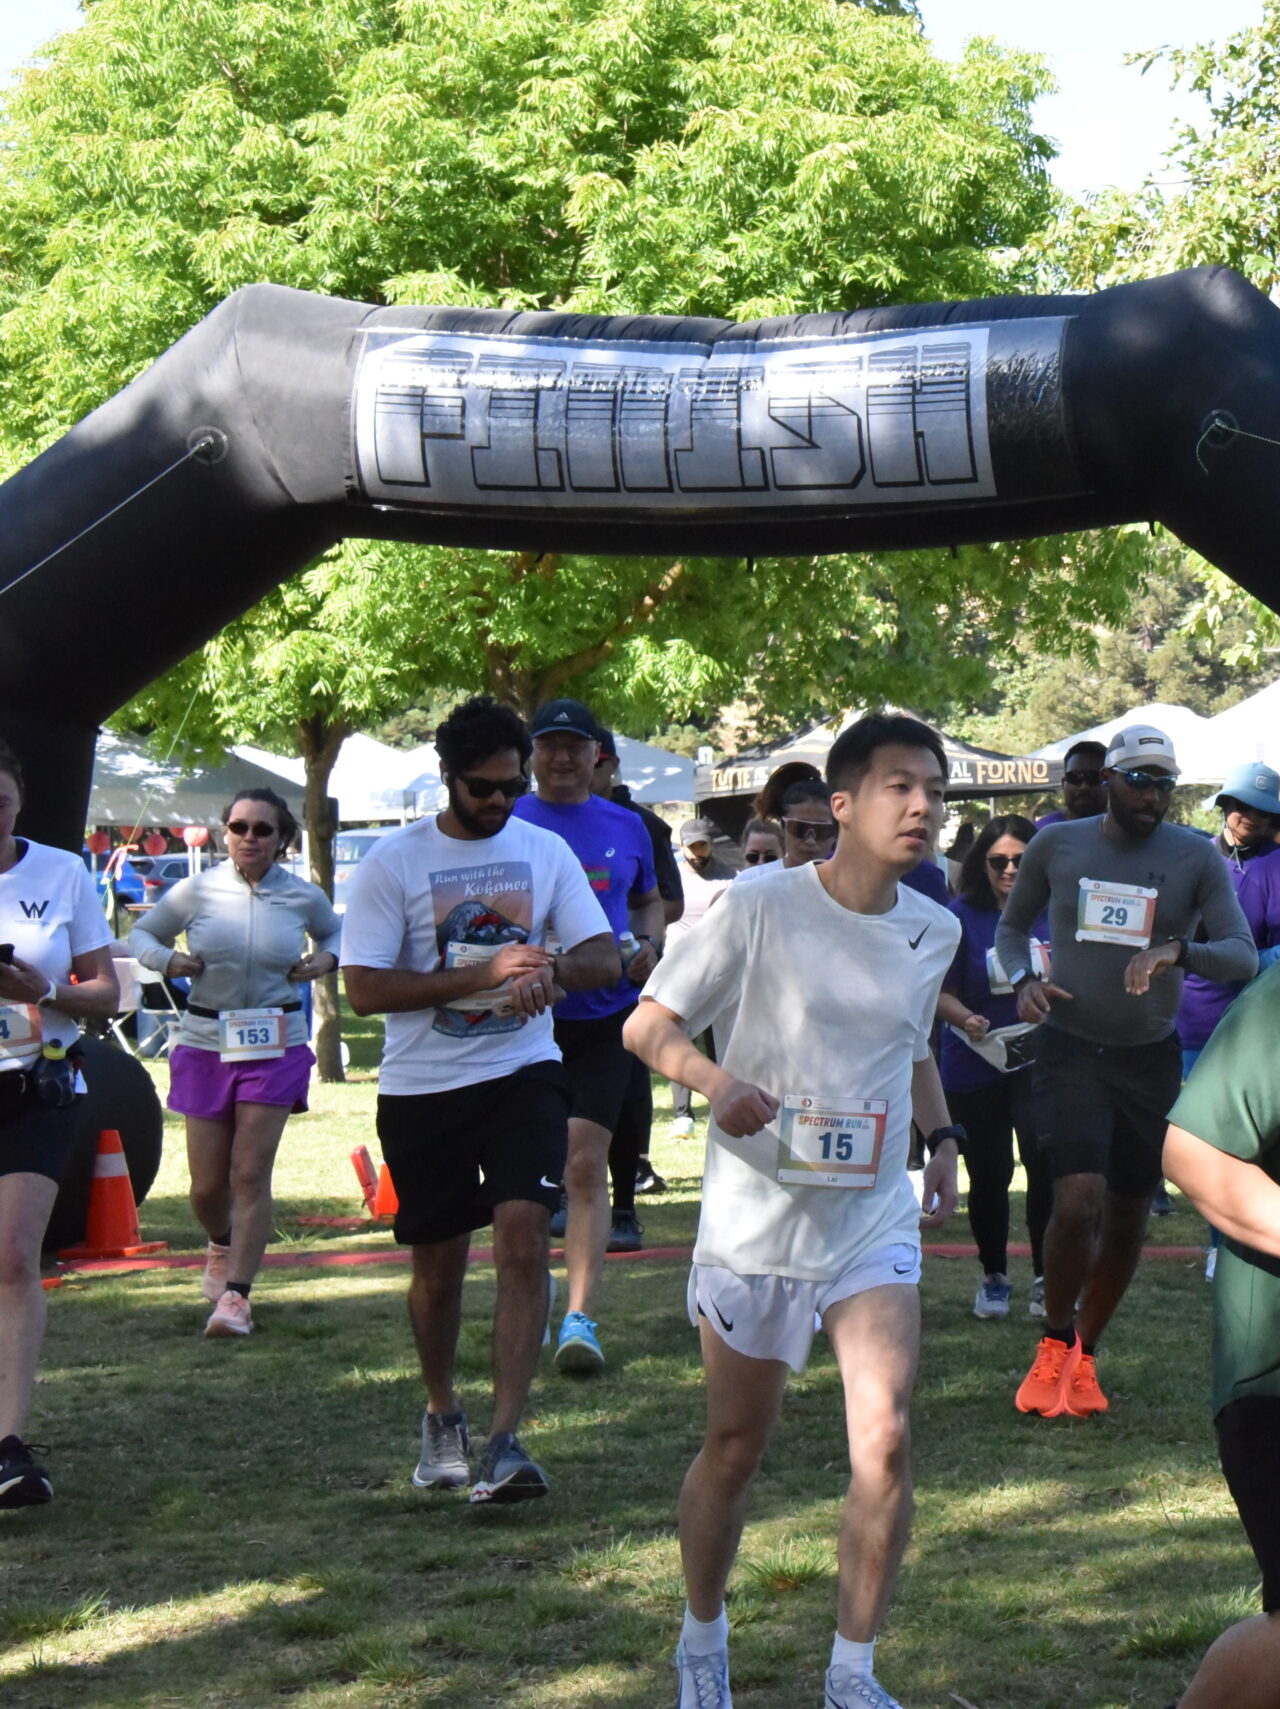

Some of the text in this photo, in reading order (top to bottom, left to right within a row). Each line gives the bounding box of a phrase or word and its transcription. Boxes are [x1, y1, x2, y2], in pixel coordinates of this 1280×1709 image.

[374, 342, 981, 495] FINISH
[950, 760, 1049, 785] AL FORNO
[435, 865, 505, 884] Run with the
[1101, 905, 1128, 926] 29
[236, 1027, 270, 1045] 153
[798, 1115, 843, 1129] SPECTRUM
[845, 1119, 863, 1129] RUN
[818, 1132, 853, 1161] 15
